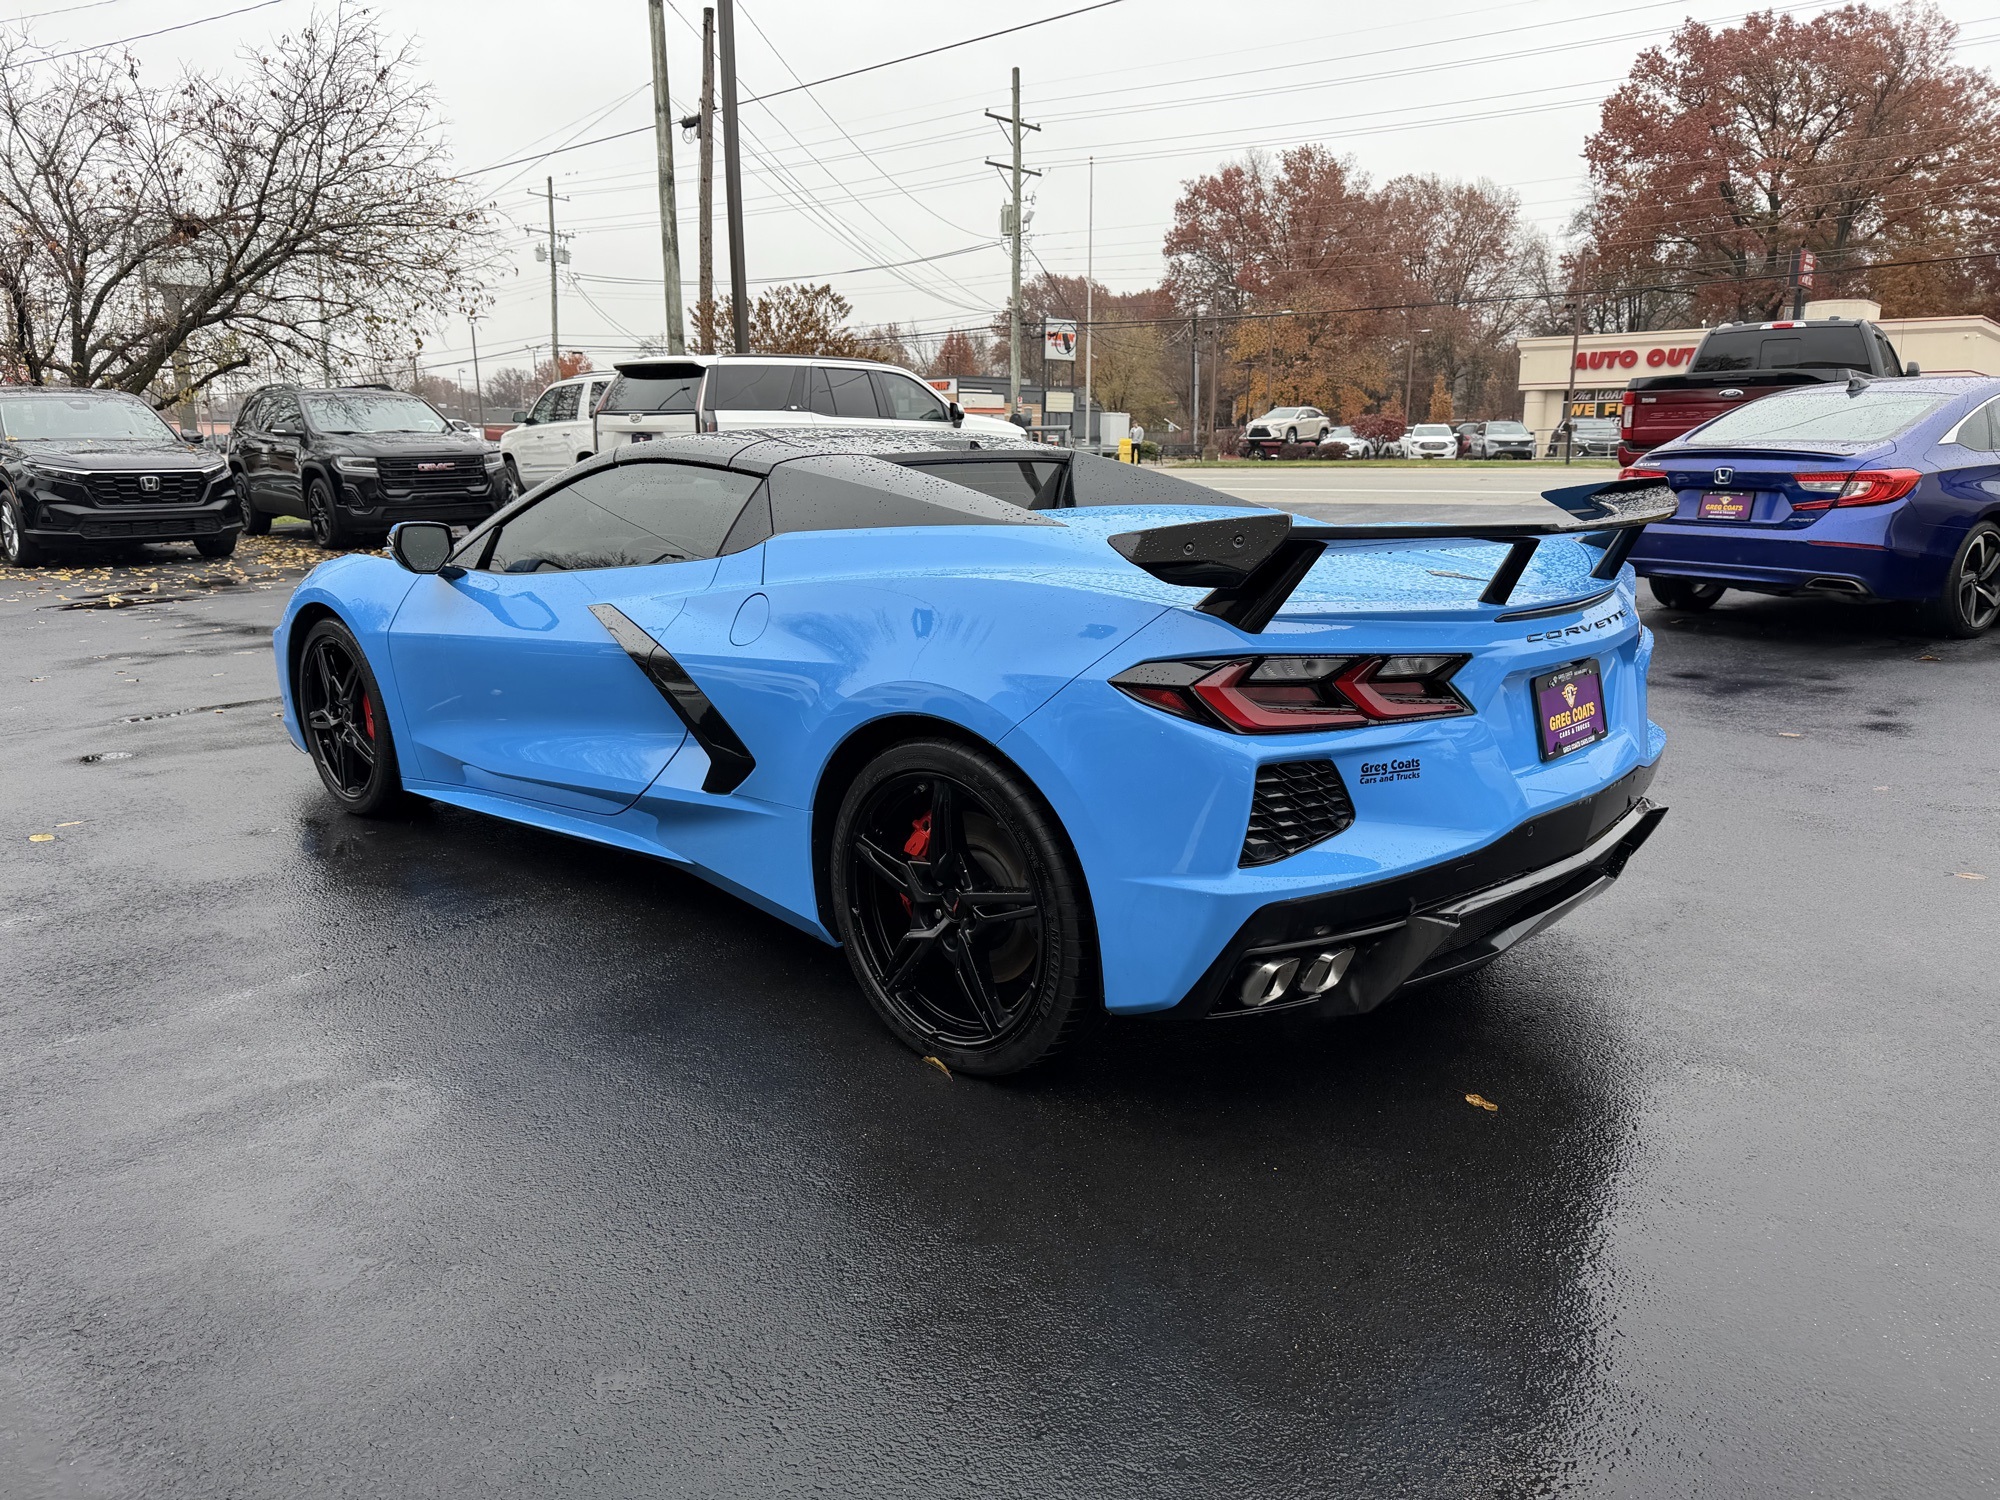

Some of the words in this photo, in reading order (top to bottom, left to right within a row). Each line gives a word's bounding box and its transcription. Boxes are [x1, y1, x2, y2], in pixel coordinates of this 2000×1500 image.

[1576, 350, 1638, 370] AUTO
[1573, 390, 1592, 401] The
[1571, 403, 1595, 416] WE
[417, 462, 456, 472] GMC
[1722, 504, 1744, 512] COATS
[1527, 608, 1629, 643] CORVETTE
[1549, 711, 1571, 732] GREG
[1572, 701, 1595, 722] COATS
[1559, 727, 1571, 739] CARS
[1575, 722, 1590, 733] TRUCKS
[1360, 762, 1388, 776] Greg
[1390, 757, 1420, 770] Coats
[1359, 777, 1377, 785] Cars
[1378, 774, 1394, 783] and
[1396, 771, 1420, 781] Trucks
